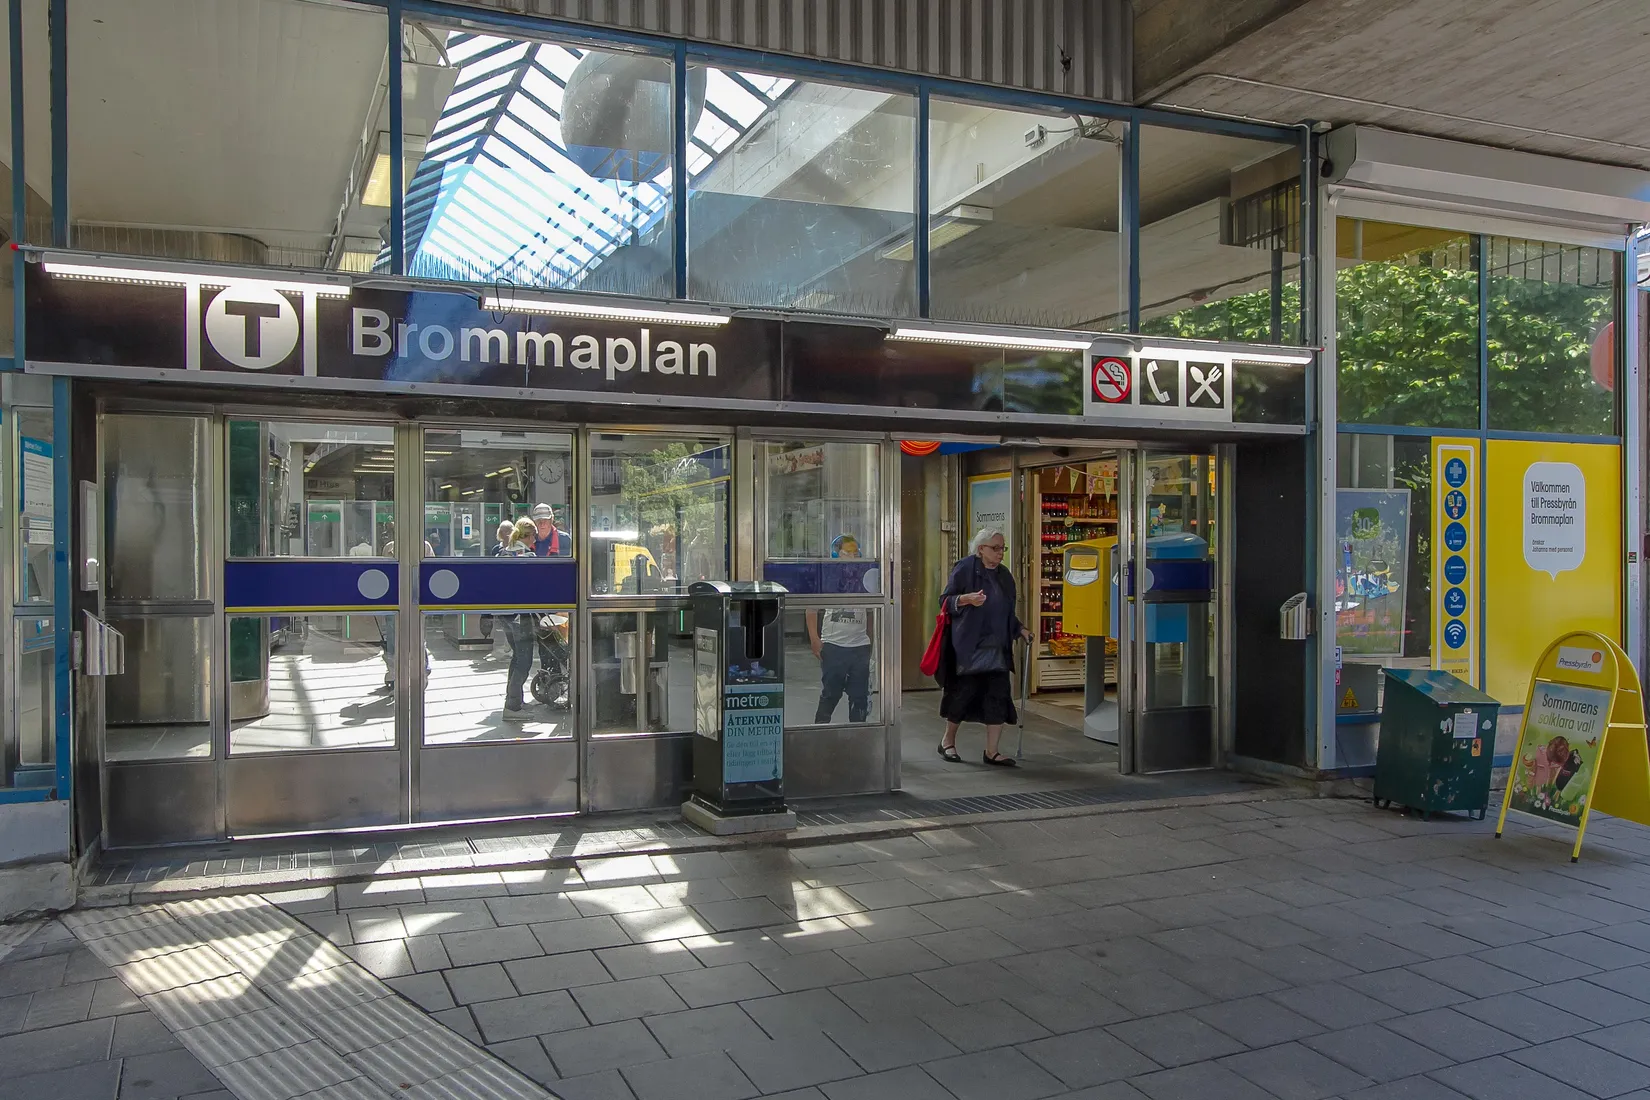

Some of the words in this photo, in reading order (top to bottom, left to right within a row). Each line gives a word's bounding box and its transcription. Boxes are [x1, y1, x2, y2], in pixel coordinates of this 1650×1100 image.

[351, 306, 718, 381] Brommaplan
[1530, 480, 1571, 494] Välkommen
[1530, 497, 1540, 509] till
[1540, 497, 1577, 511] Pressbyrån
[976, 511, 1005, 522] Sommarens
[1530, 512, 1574, 527] Brommaplan
[1557, 546, 1574, 554] personal
[1558, 657, 1592, 669] Pressbyrån
[726, 693, 769, 707] metro
[1542, 693, 1599, 716] Sommarens
[727, 714, 781, 727] ÅTERVINN
[1538, 712, 1575, 730] solklara
[1577, 719, 1596, 734] val!
[727, 727, 745, 738] DIN
[747, 725, 781, 737] METRO
